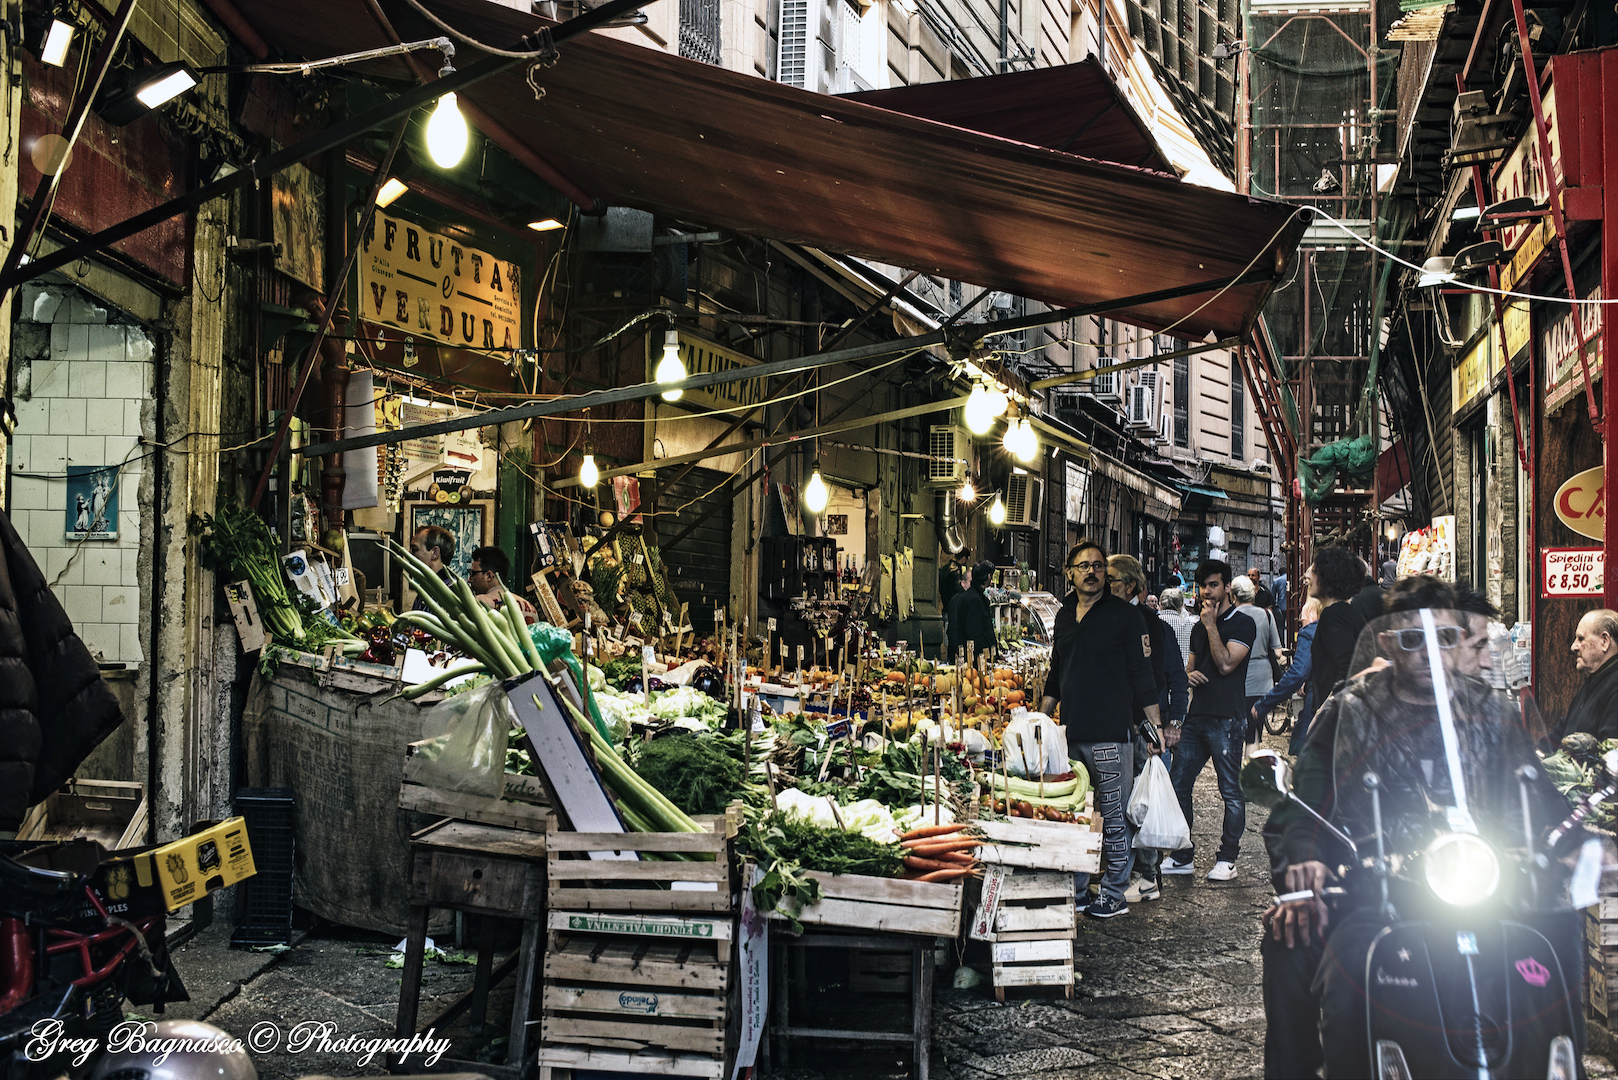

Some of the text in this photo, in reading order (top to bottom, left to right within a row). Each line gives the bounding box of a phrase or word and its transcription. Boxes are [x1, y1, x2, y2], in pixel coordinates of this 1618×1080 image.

[384, 218, 503, 292] FRUTTA
[371, 265, 395, 279] Giuseppe
[442, 275, 455, 299] e
[370, 281, 513, 355] VERDURA
[680, 340, 761, 406] ALUMERIA
[435, 475, 466, 485] Kiwifruit
[1548, 554, 1593, 564] Spiedini
[1564, 563, 1593, 572] Pollo
[1560, 573, 1589, 591] 8,50
[1092, 743, 1129, 873] HARVARD
[586, 920, 693, 936] FUNGHI VALENTINA
[621, 993, 656, 1008] Melinda
